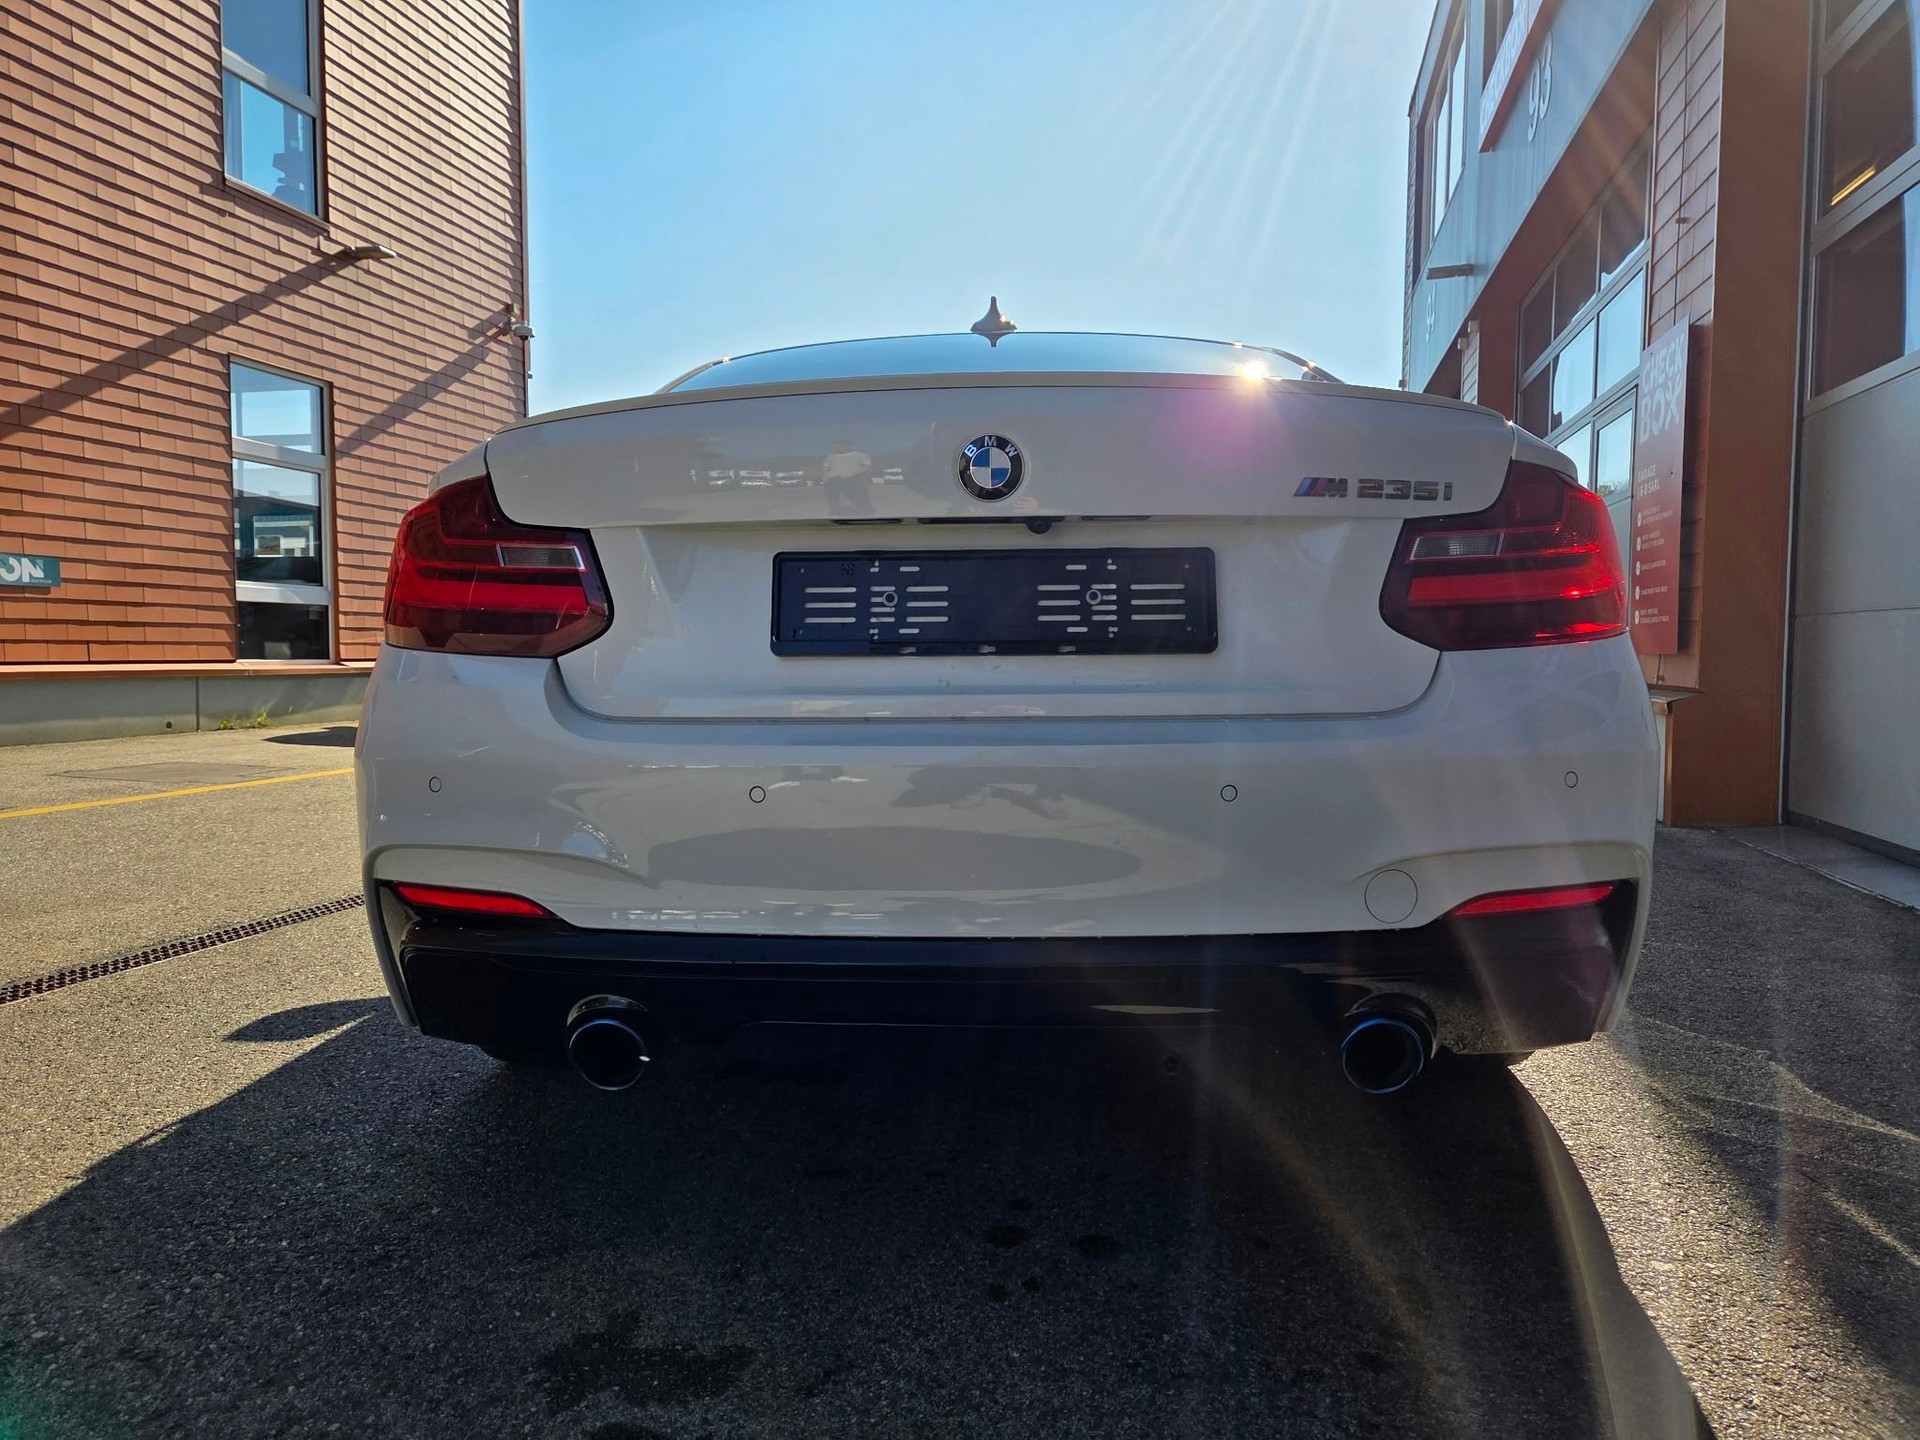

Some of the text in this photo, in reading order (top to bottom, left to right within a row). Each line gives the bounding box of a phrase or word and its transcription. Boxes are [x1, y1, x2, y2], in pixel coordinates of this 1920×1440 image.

[1528, 28, 1552, 142] 93
[1642, 333, 1684, 393] CHECK
[1640, 373, 1682, 443] BOX
[964, 435, 1018, 457] BMW
[1638, 464, 1656, 482] GARAGE
